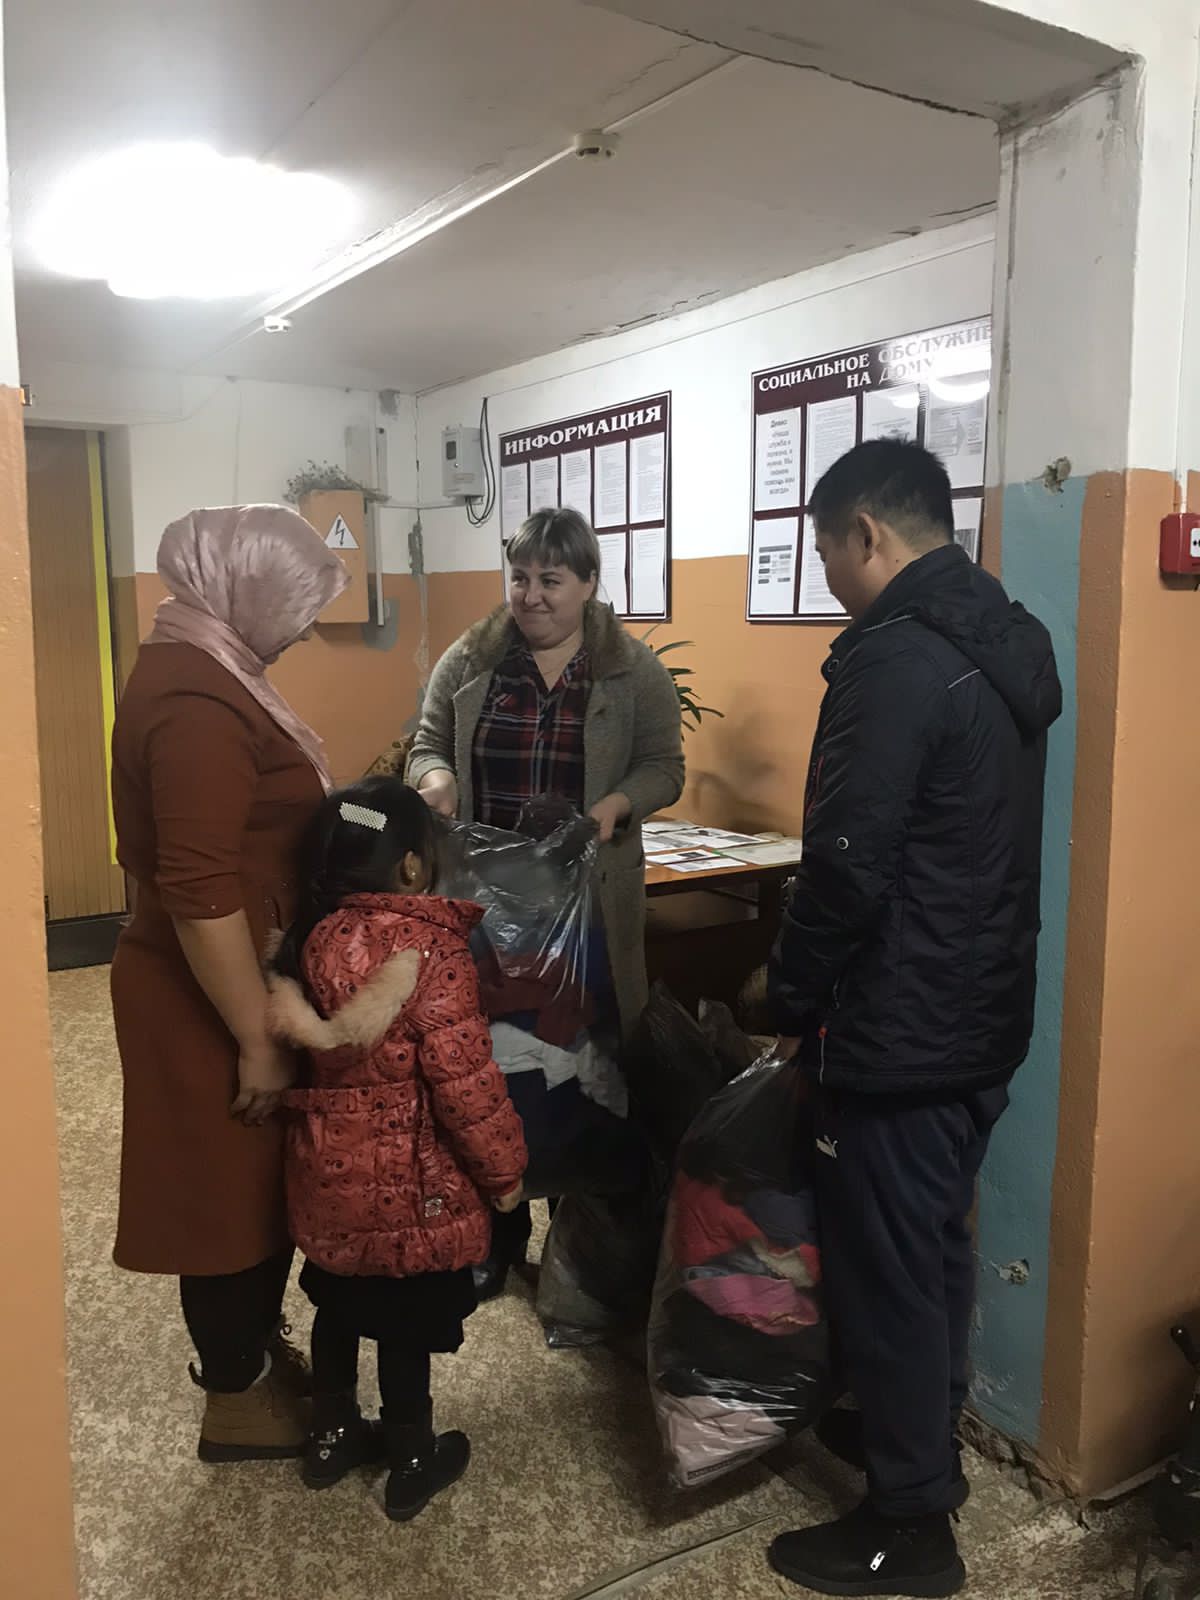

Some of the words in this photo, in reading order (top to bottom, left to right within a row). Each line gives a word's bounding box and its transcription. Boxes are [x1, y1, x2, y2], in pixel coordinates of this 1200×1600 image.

[758, 353, 871, 393] СОЦИАЛЬНОЕ
[846, 372, 872, 390] НА
[879, 356, 934, 384] ДОМУ
[504, 405, 662, 455] ИНФОРМАЦИЯ
